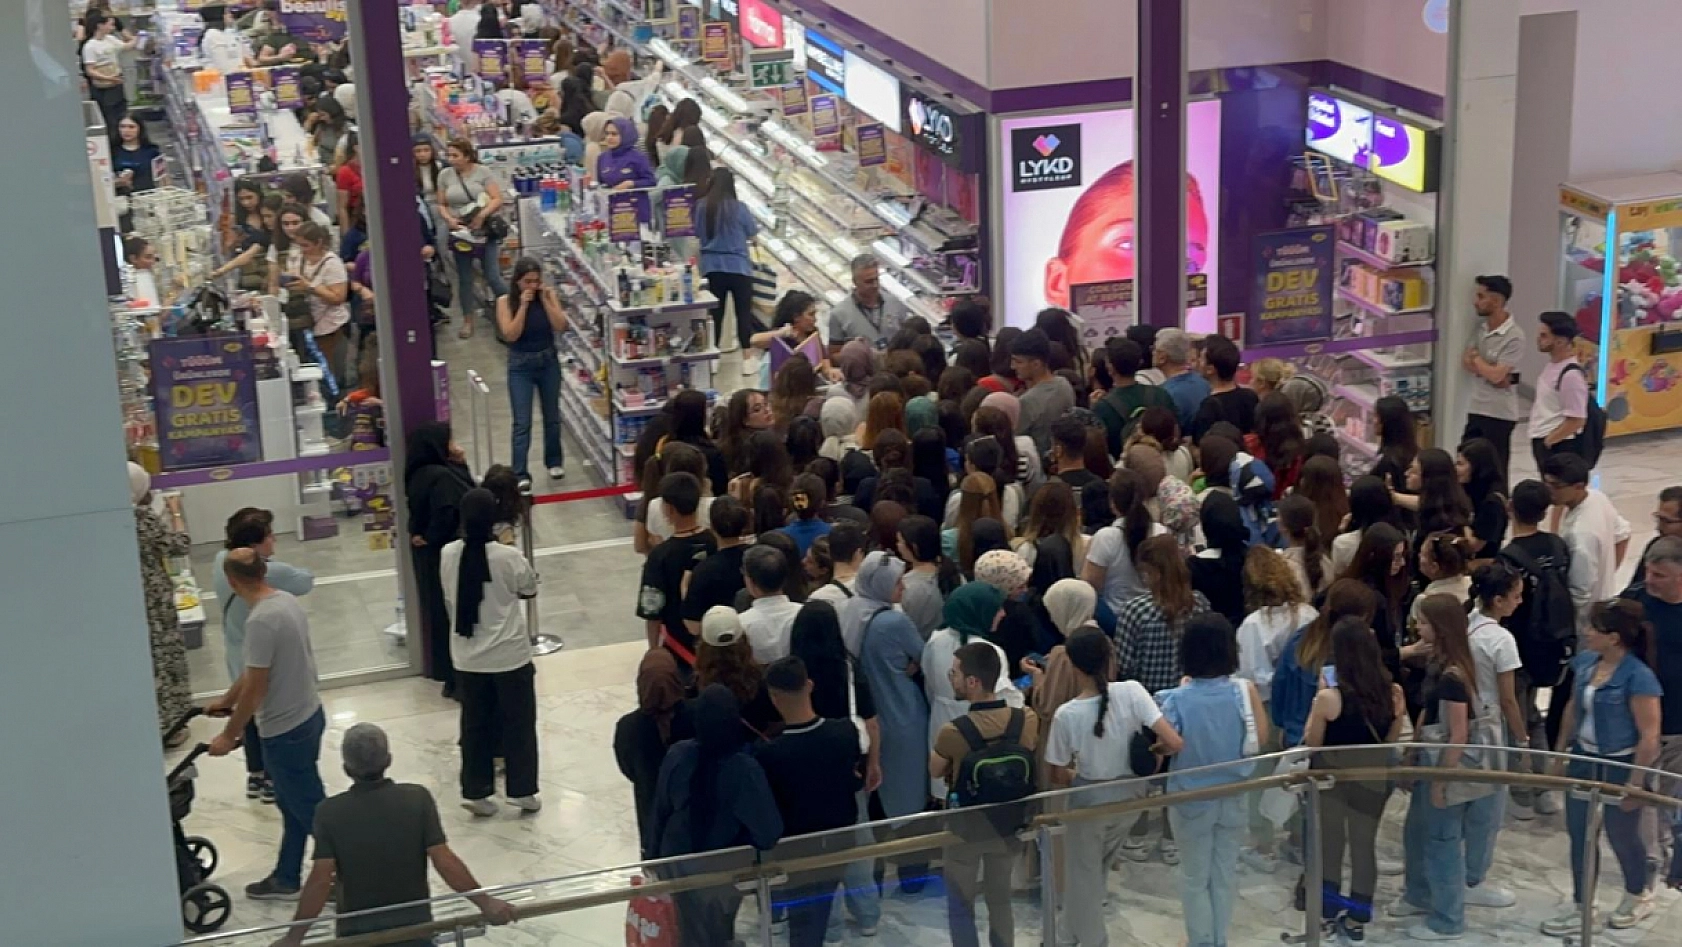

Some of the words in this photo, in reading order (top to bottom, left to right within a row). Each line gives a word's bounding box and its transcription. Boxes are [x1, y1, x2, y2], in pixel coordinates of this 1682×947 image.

[1019, 157, 1073, 178] LYKD
[1266, 268, 1319, 292] DEV
[1265, 292, 1320, 310] GRATIS
[171, 381, 237, 408] DEV
[171, 409, 242, 428] GRATIS
